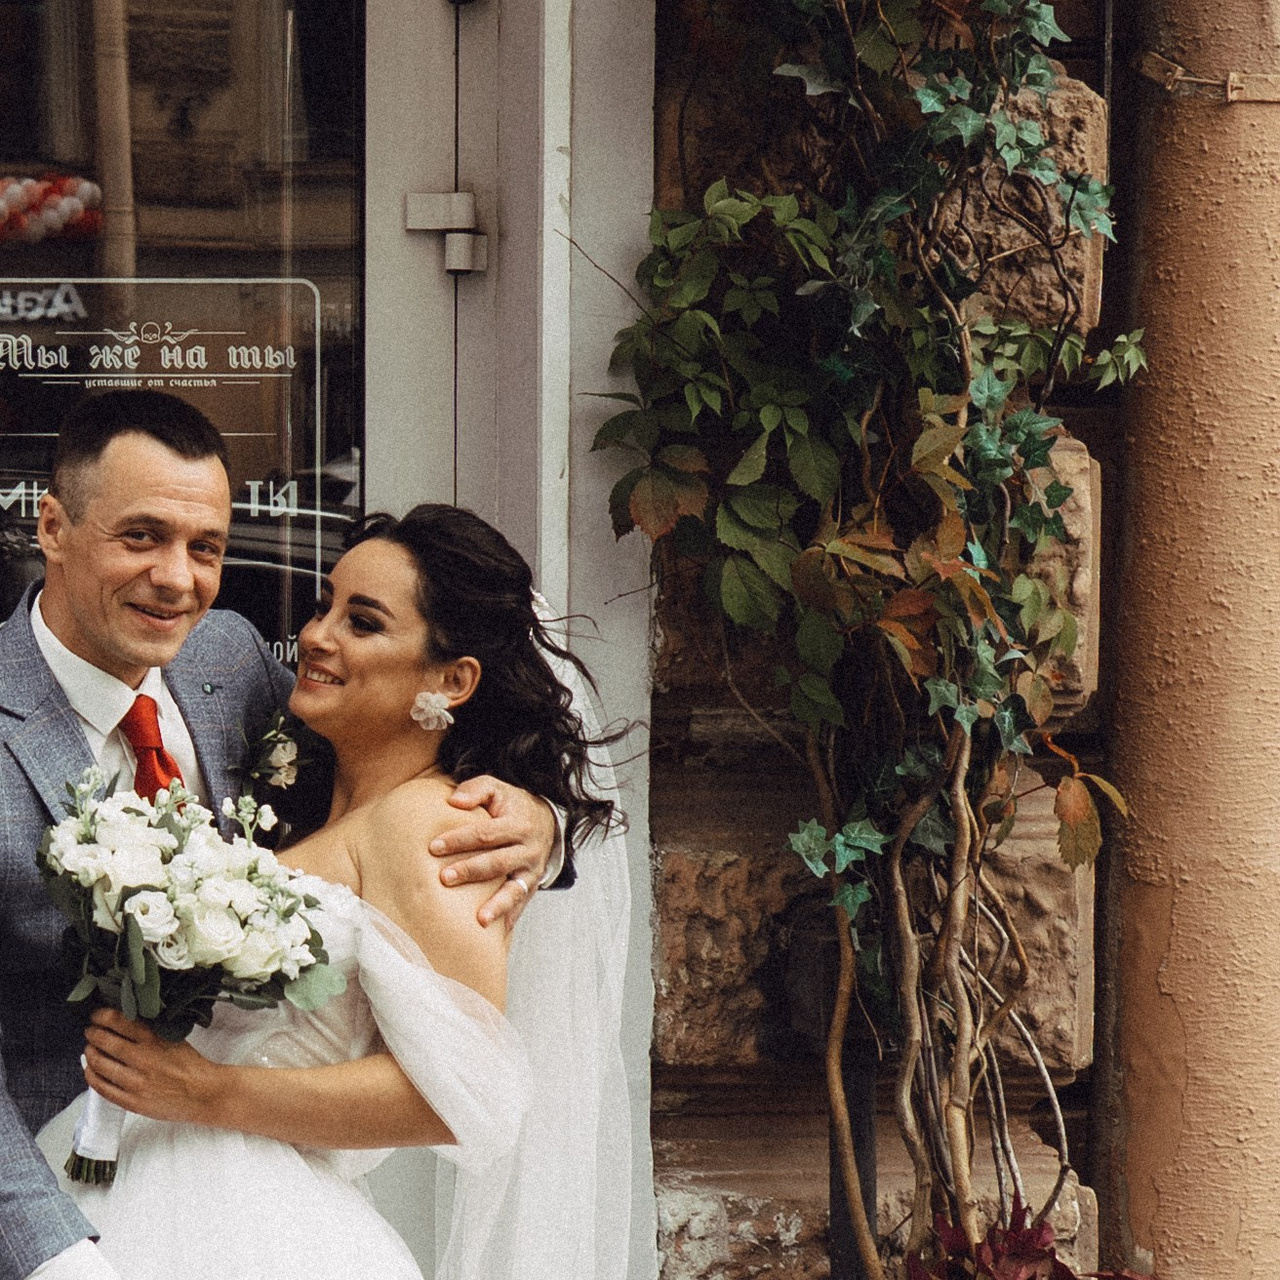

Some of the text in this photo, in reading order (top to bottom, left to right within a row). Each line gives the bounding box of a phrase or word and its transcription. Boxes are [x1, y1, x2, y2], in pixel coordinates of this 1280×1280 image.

[89, 343, 141, 370] же
[159, 345, 209, 370] на
[227, 343, 298, 370] ты
[84, 379, 143, 388] уставшие
[147, 379, 165, 388] от
